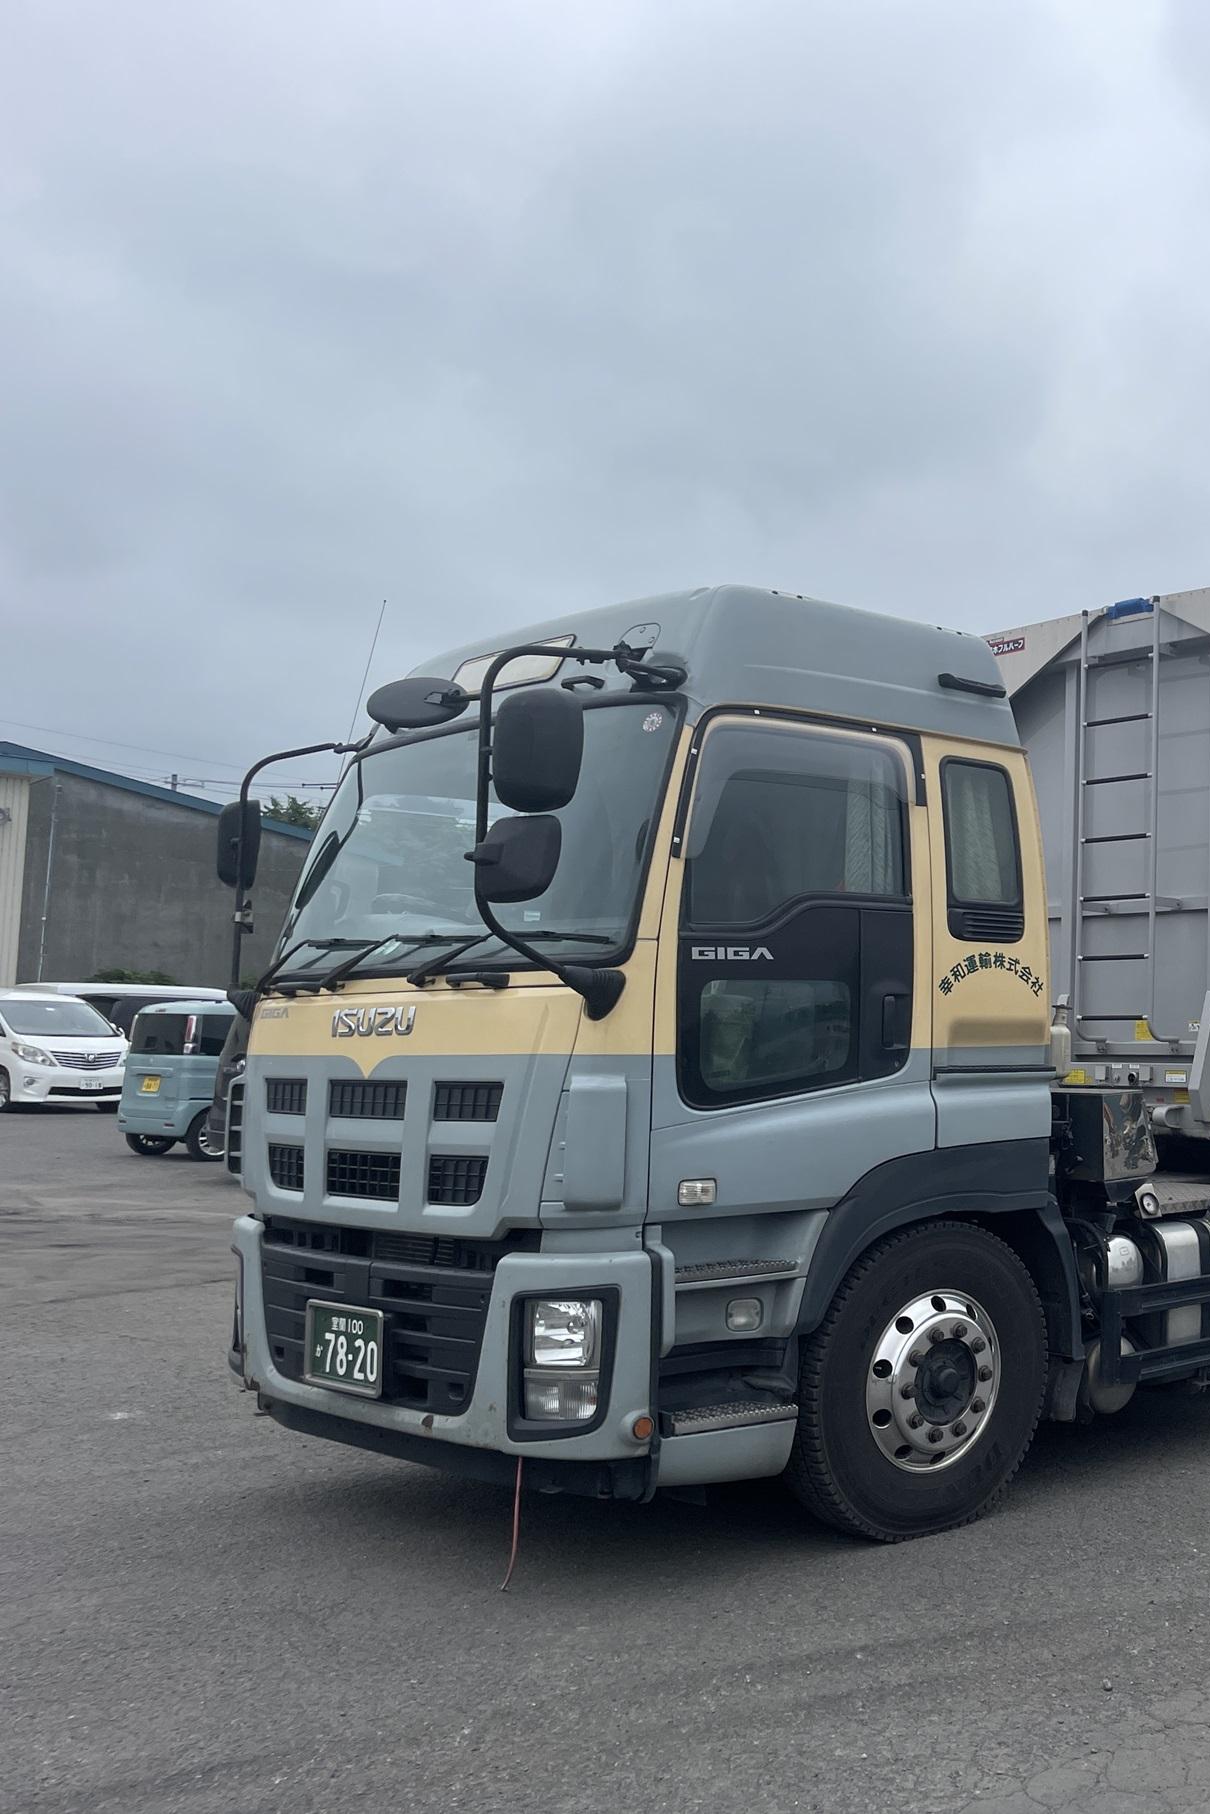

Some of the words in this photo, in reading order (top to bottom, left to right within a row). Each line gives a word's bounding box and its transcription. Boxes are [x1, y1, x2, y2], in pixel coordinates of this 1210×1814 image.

[991, 639, 1024, 654] 本フルハーフ
[691, 946, 775, 960] GIGA
[938, 951, 1044, 997] 幸和運輸株式会社
[260, 1007, 289, 1019] GIGA
[331, 1005, 416, 1038] ISUZU
[347, 1318, 364, 1335] 100
[324, 1332, 378, 1382] 78-20
